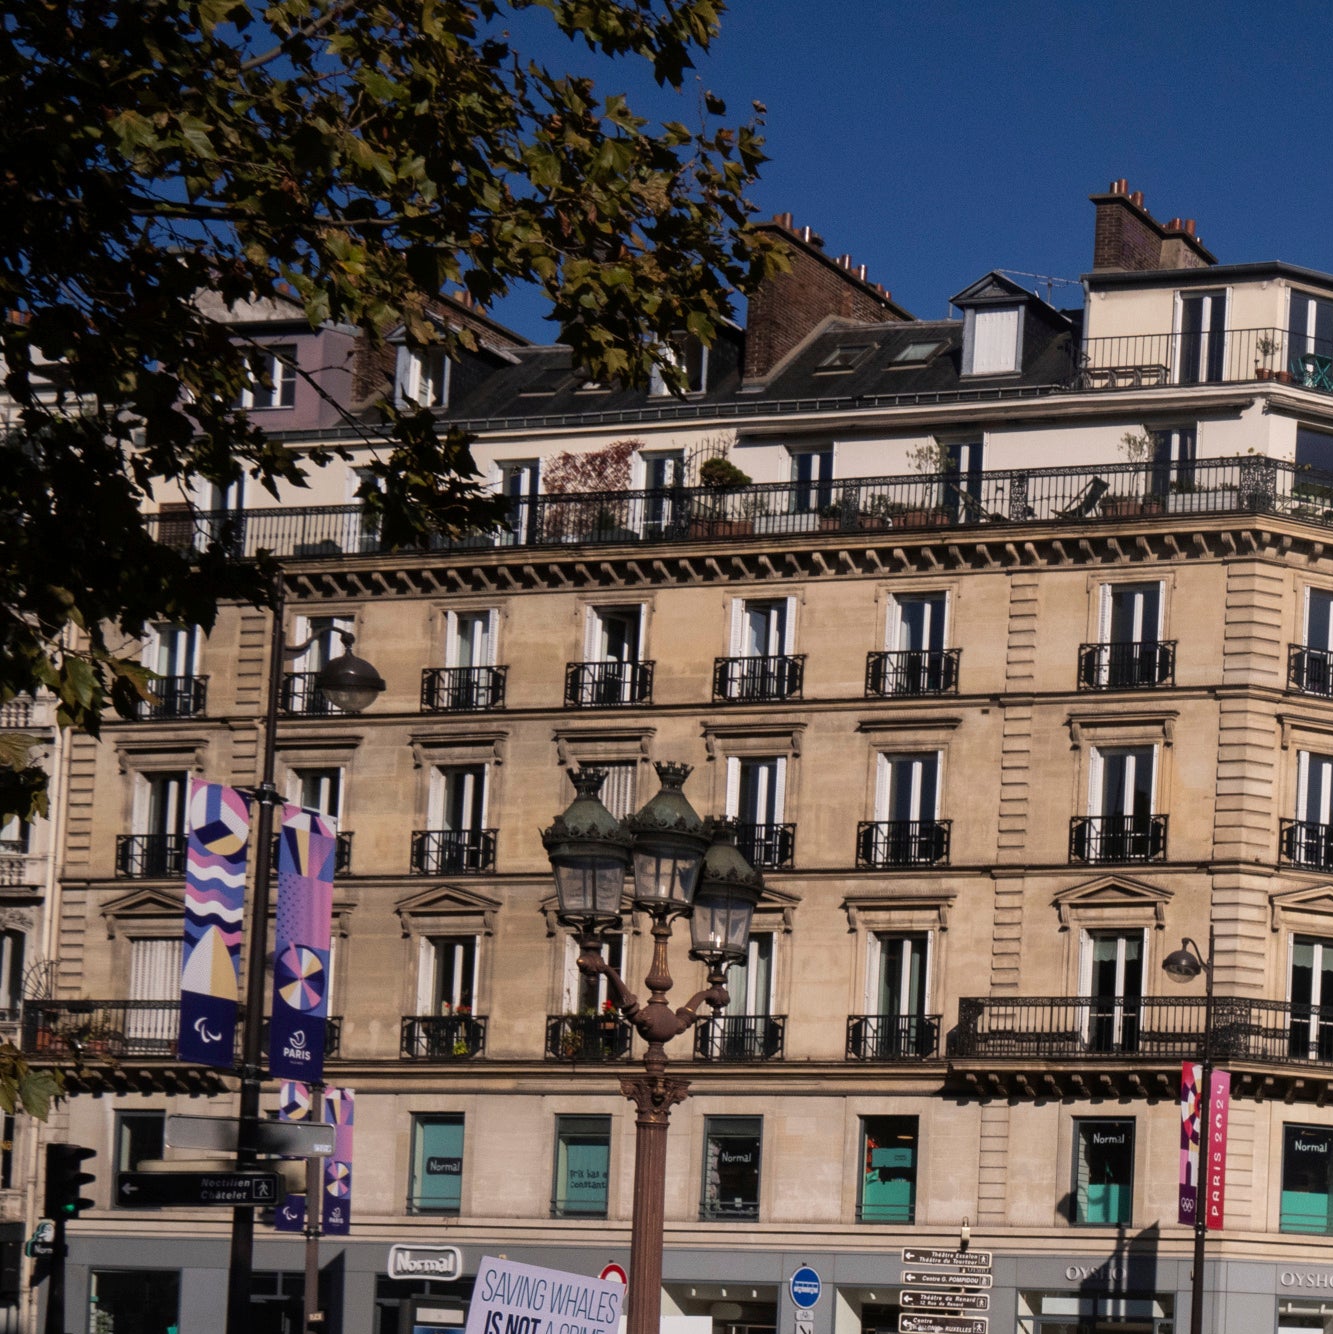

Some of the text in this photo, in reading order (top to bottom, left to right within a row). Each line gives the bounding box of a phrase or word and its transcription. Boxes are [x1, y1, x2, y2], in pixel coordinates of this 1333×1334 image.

[283, 1047, 311, 1061] PARIS
[1093, 1132, 1125, 1145] Normal
[1211, 1084, 1225, 1217] PARIS 2024
[1294, 1139, 1328, 1153] Normal
[722, 1152, 751, 1163] Normal
[429, 1160, 461, 1172] Normal
[201, 1177, 250, 1188] Noctilien
[201, 1189, 247, 1200] Châtelet
[329, 1216, 344, 1225] PARIS
[395, 1251, 453, 1273] Normal
[1065, 1265, 1127, 1282] OYSHO
[481, 1269, 618, 1324] SAVING WHALES
